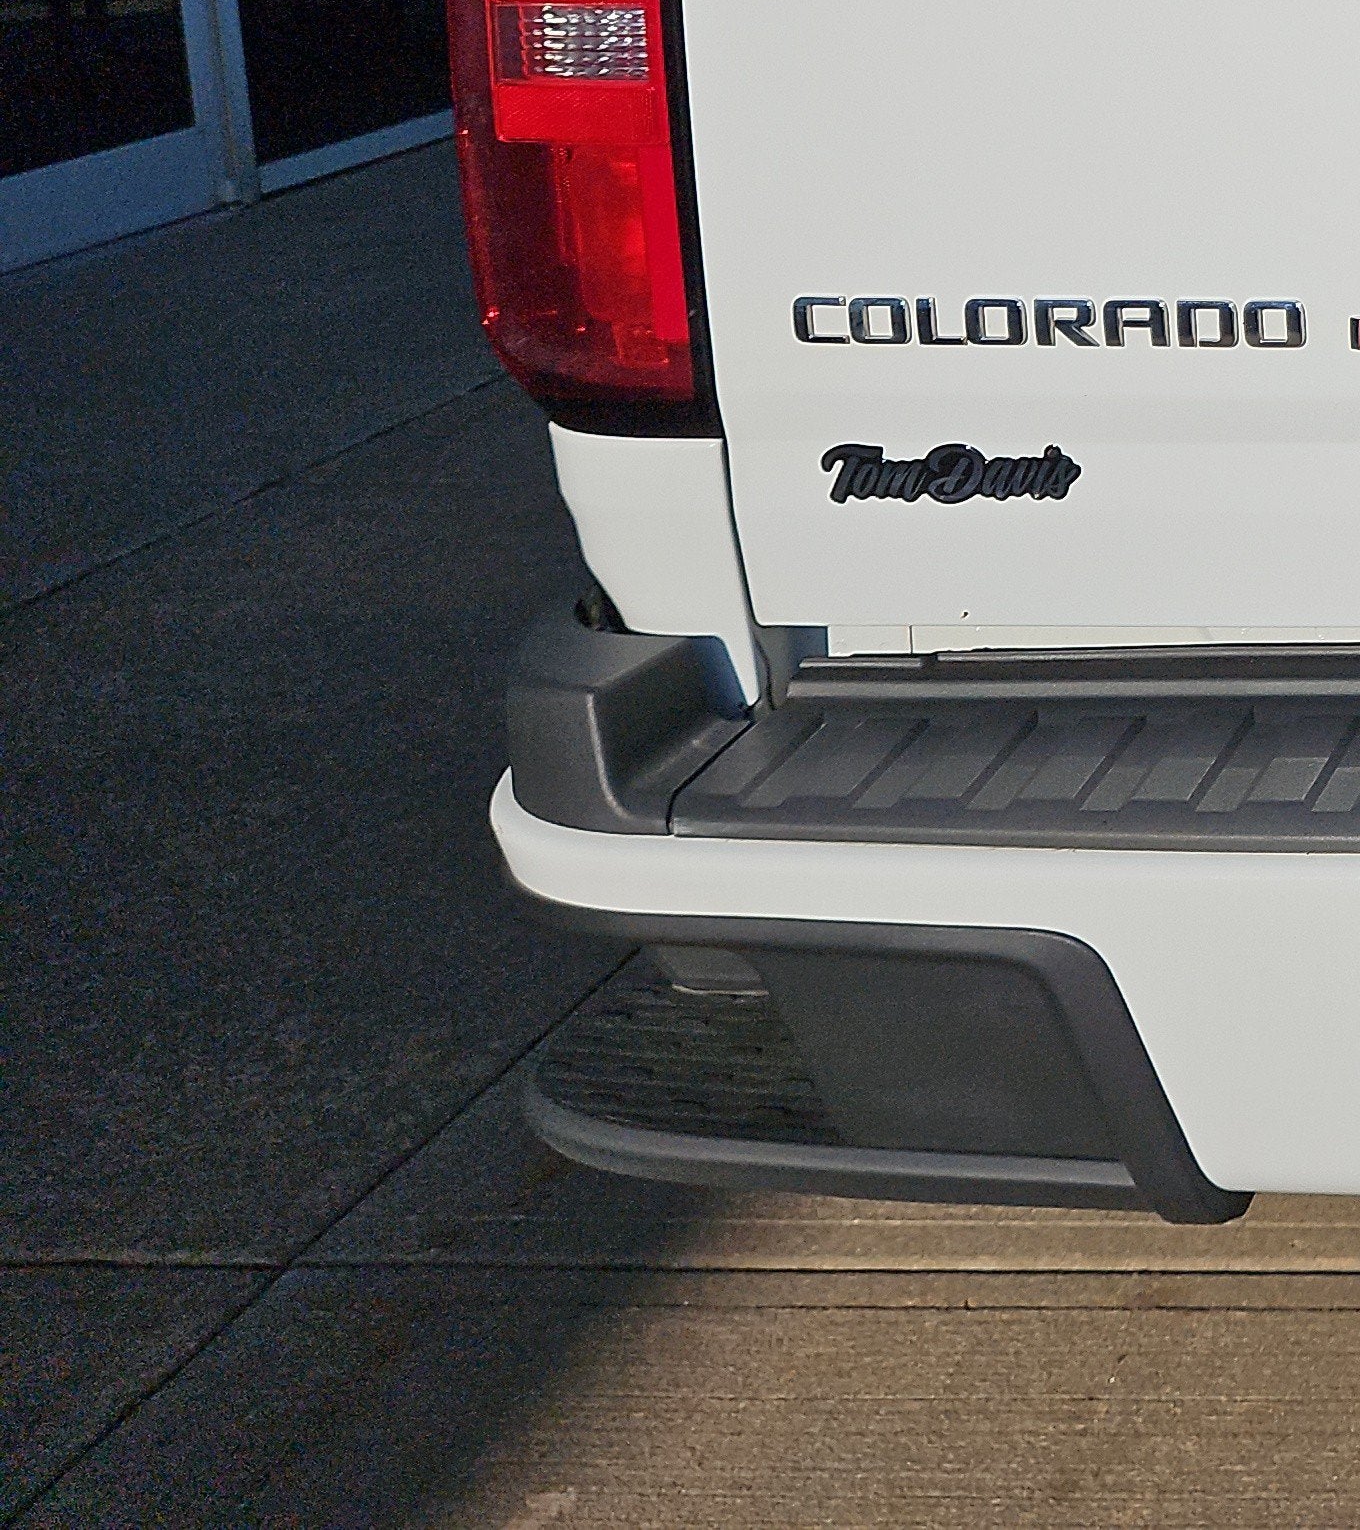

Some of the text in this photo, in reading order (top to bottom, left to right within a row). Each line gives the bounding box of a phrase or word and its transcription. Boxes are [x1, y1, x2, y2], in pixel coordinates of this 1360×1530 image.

[792, 295, 1307, 348] COLORADO
[821, 443, 1082, 504] Tom Davis
